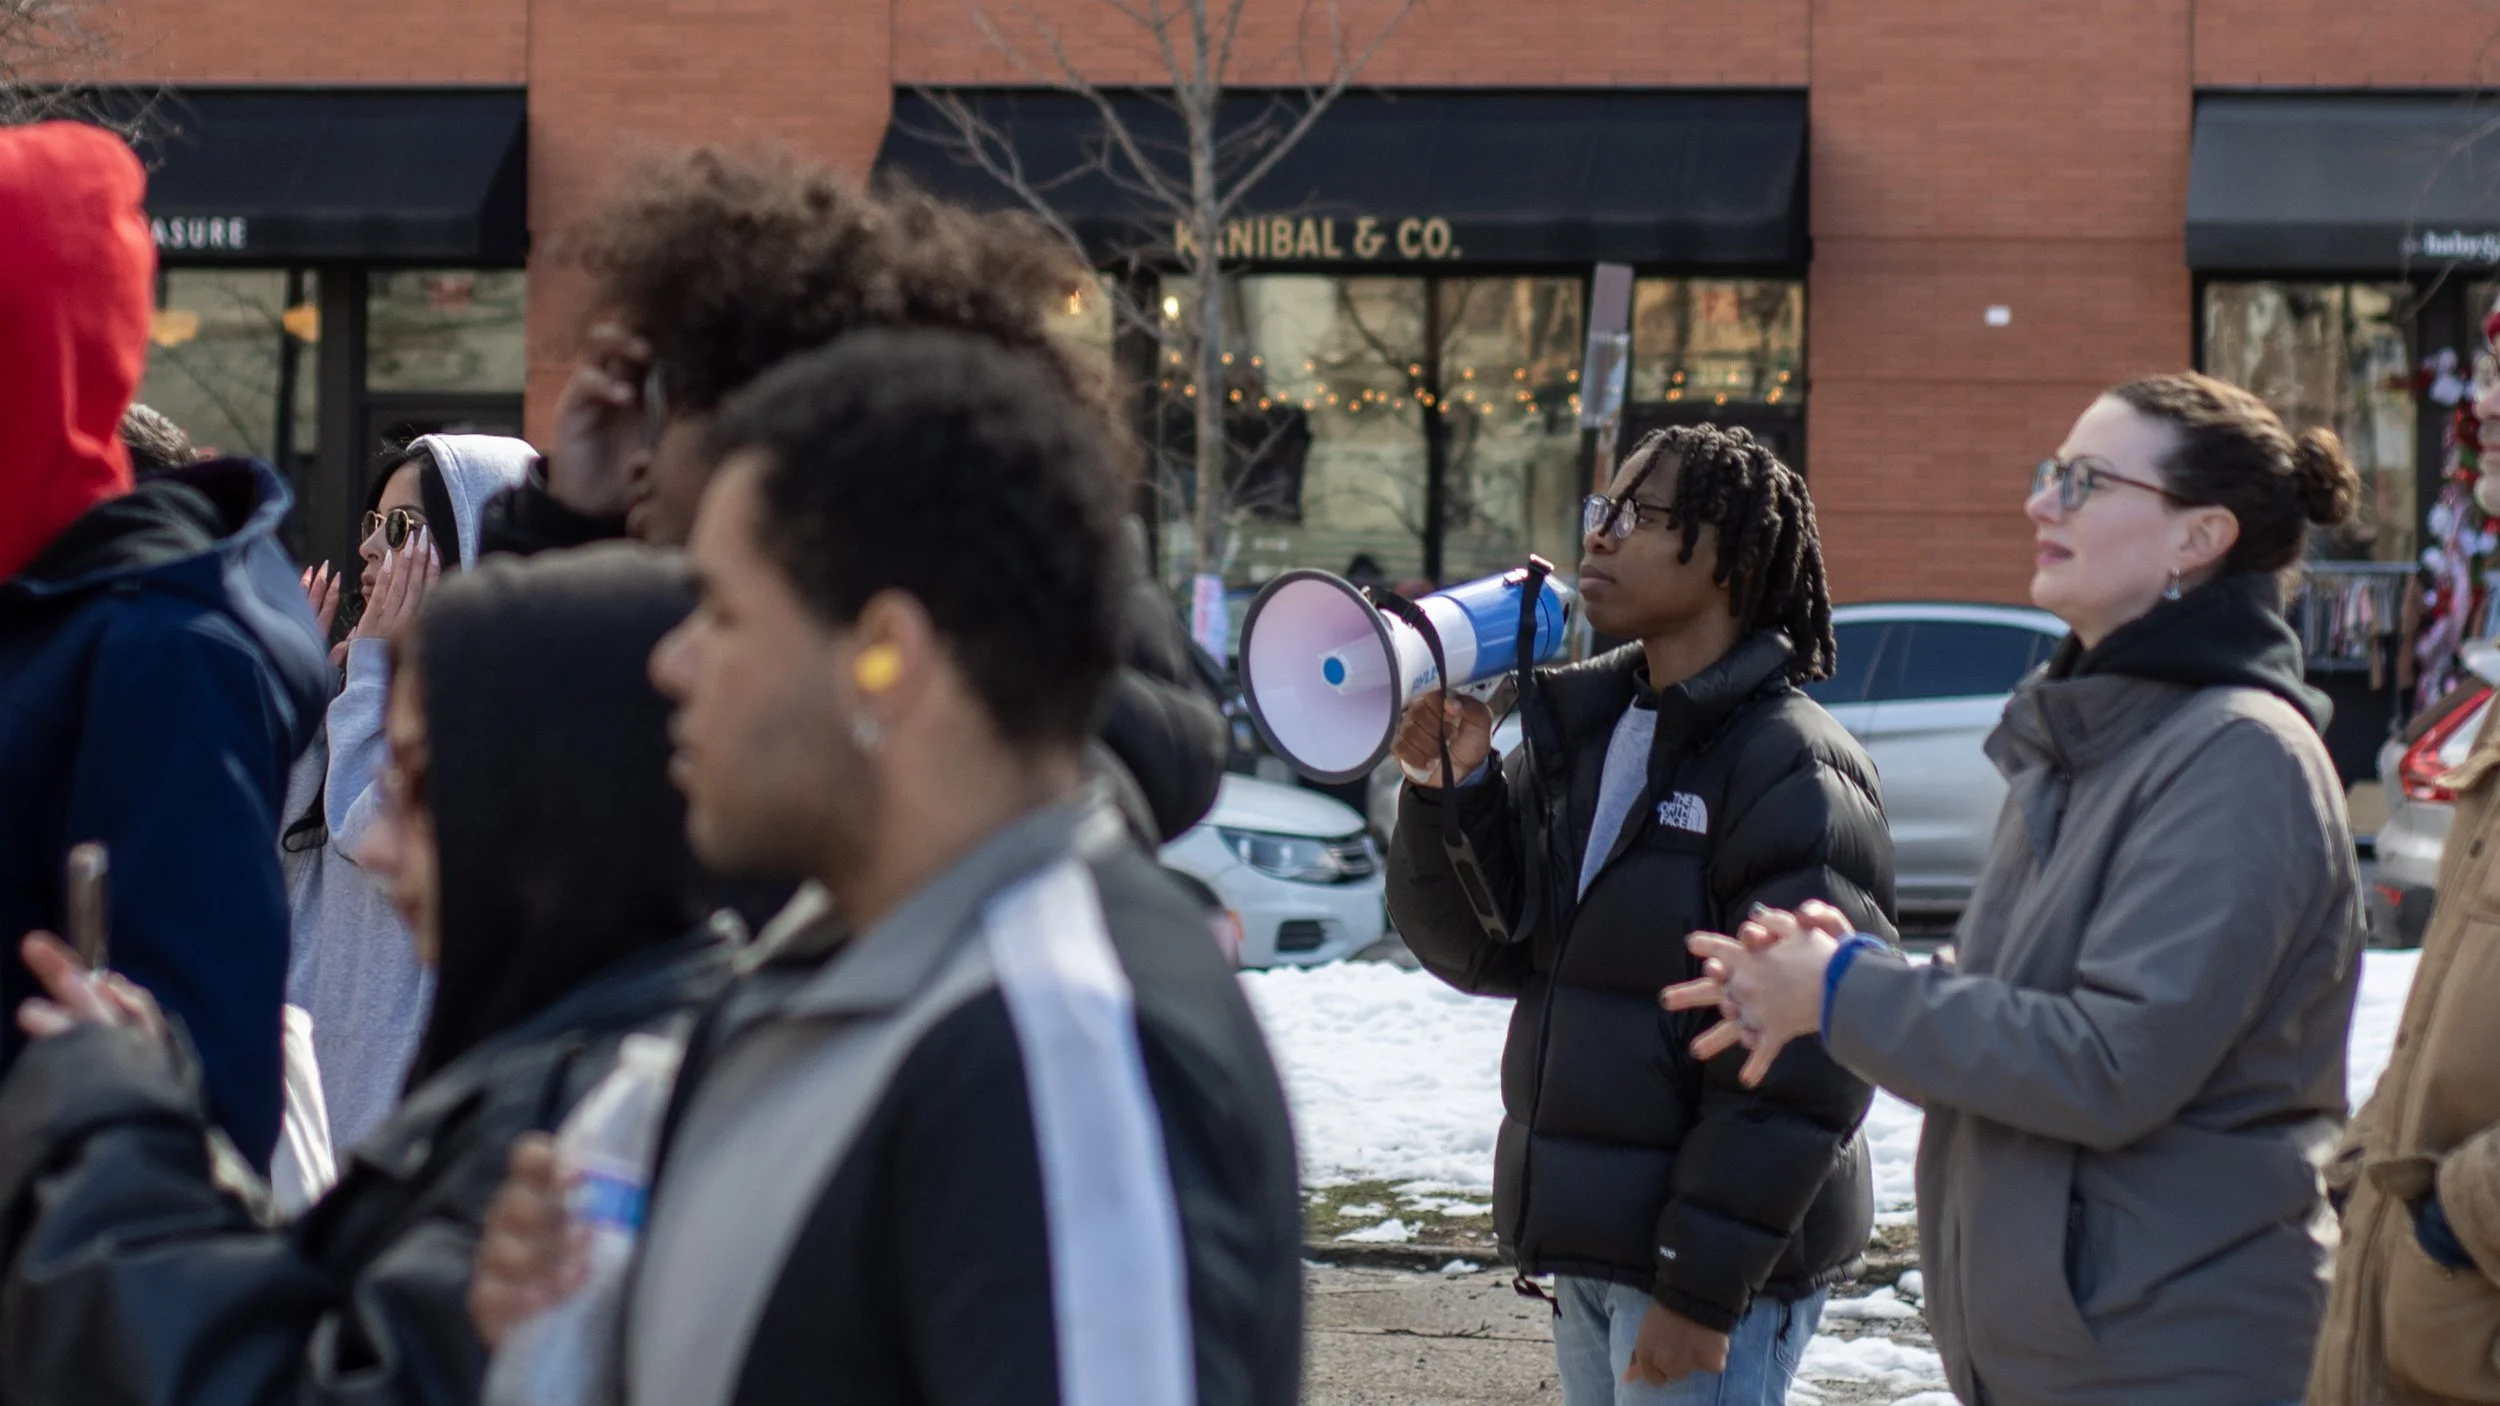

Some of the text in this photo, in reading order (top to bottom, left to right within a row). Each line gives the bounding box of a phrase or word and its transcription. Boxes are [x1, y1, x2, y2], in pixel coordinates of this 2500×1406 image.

[1354, 216, 1387, 258] &
[1399, 217, 1462, 258] CO.
[1672, 791, 1693, 807] THE
[1660, 815, 1688, 829] FACE
